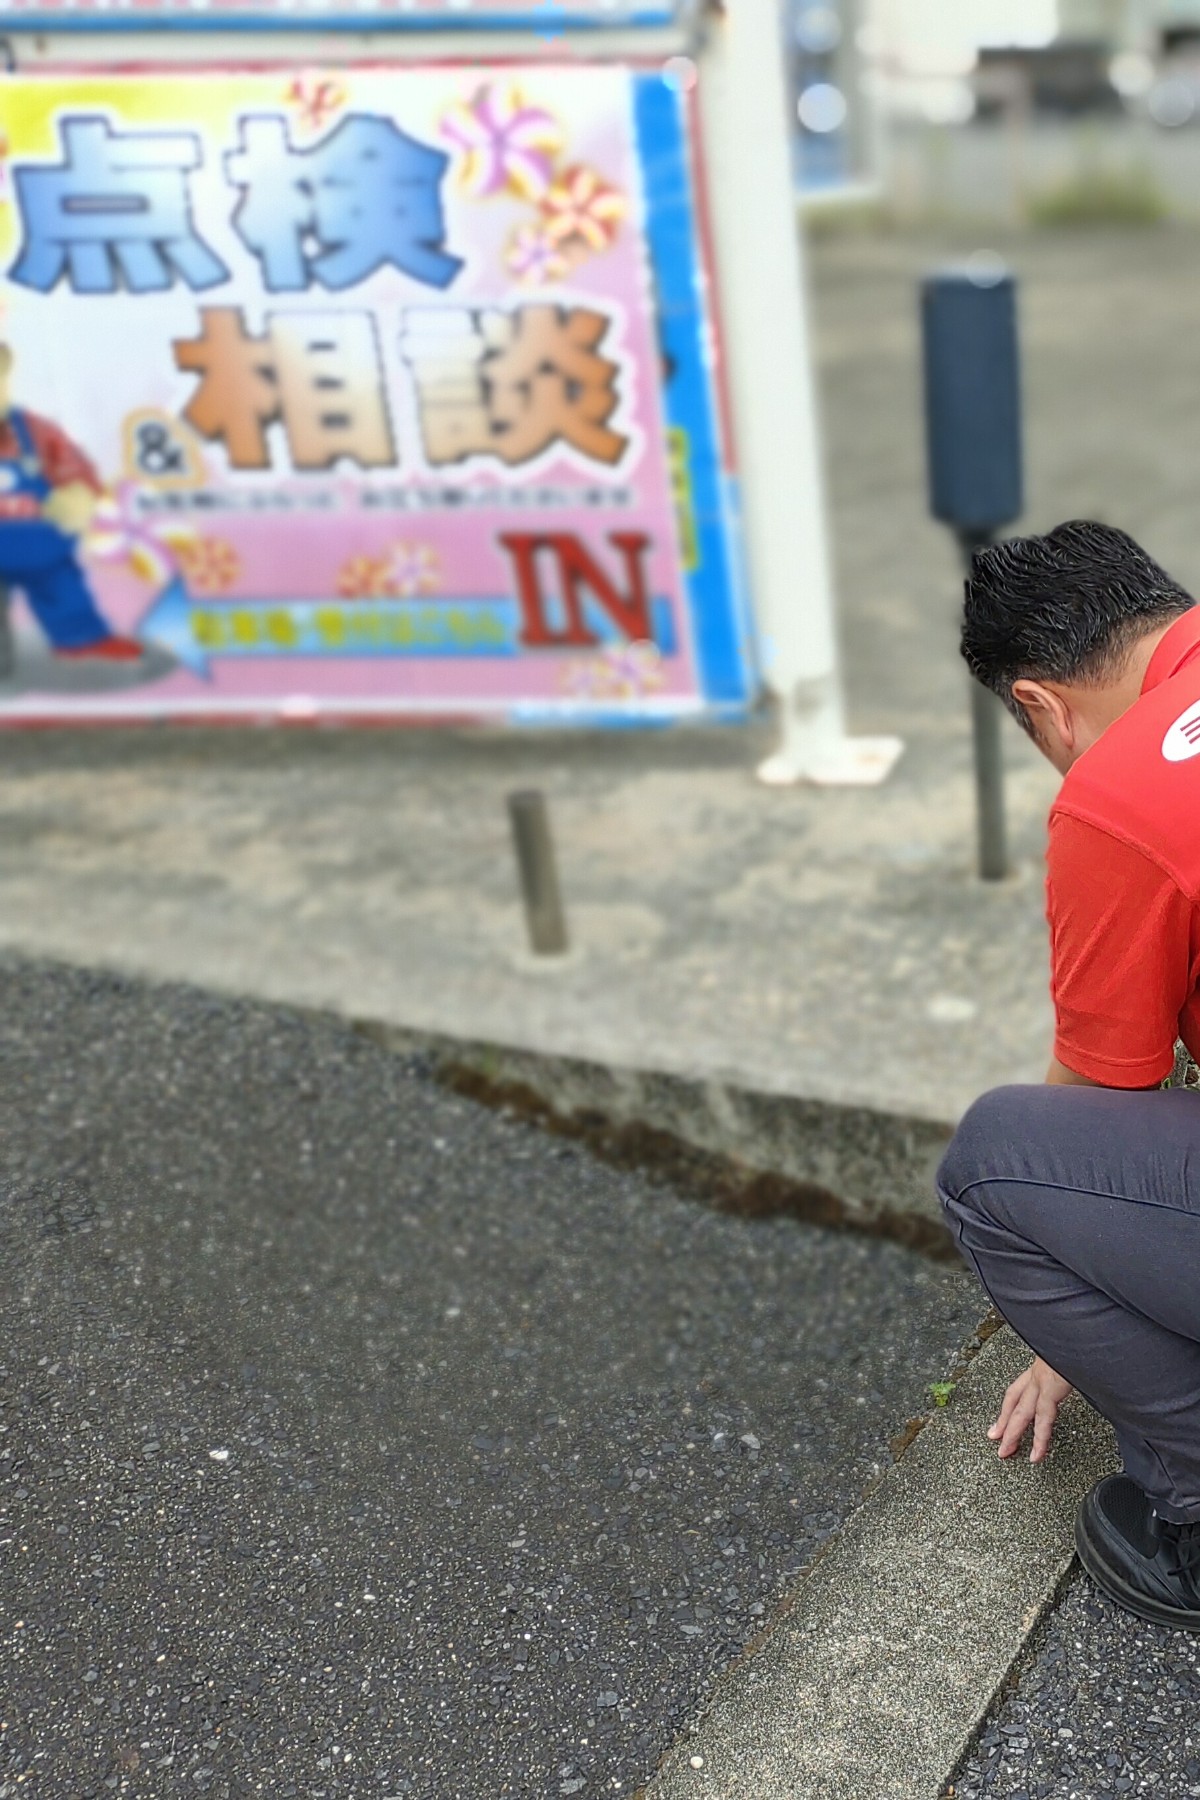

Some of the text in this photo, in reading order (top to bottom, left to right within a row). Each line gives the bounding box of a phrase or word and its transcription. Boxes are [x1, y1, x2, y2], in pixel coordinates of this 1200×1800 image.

[7, 115, 464, 293] 点検
[137, 305, 629, 474] & 相談
[499, 532, 652, 648] IN
